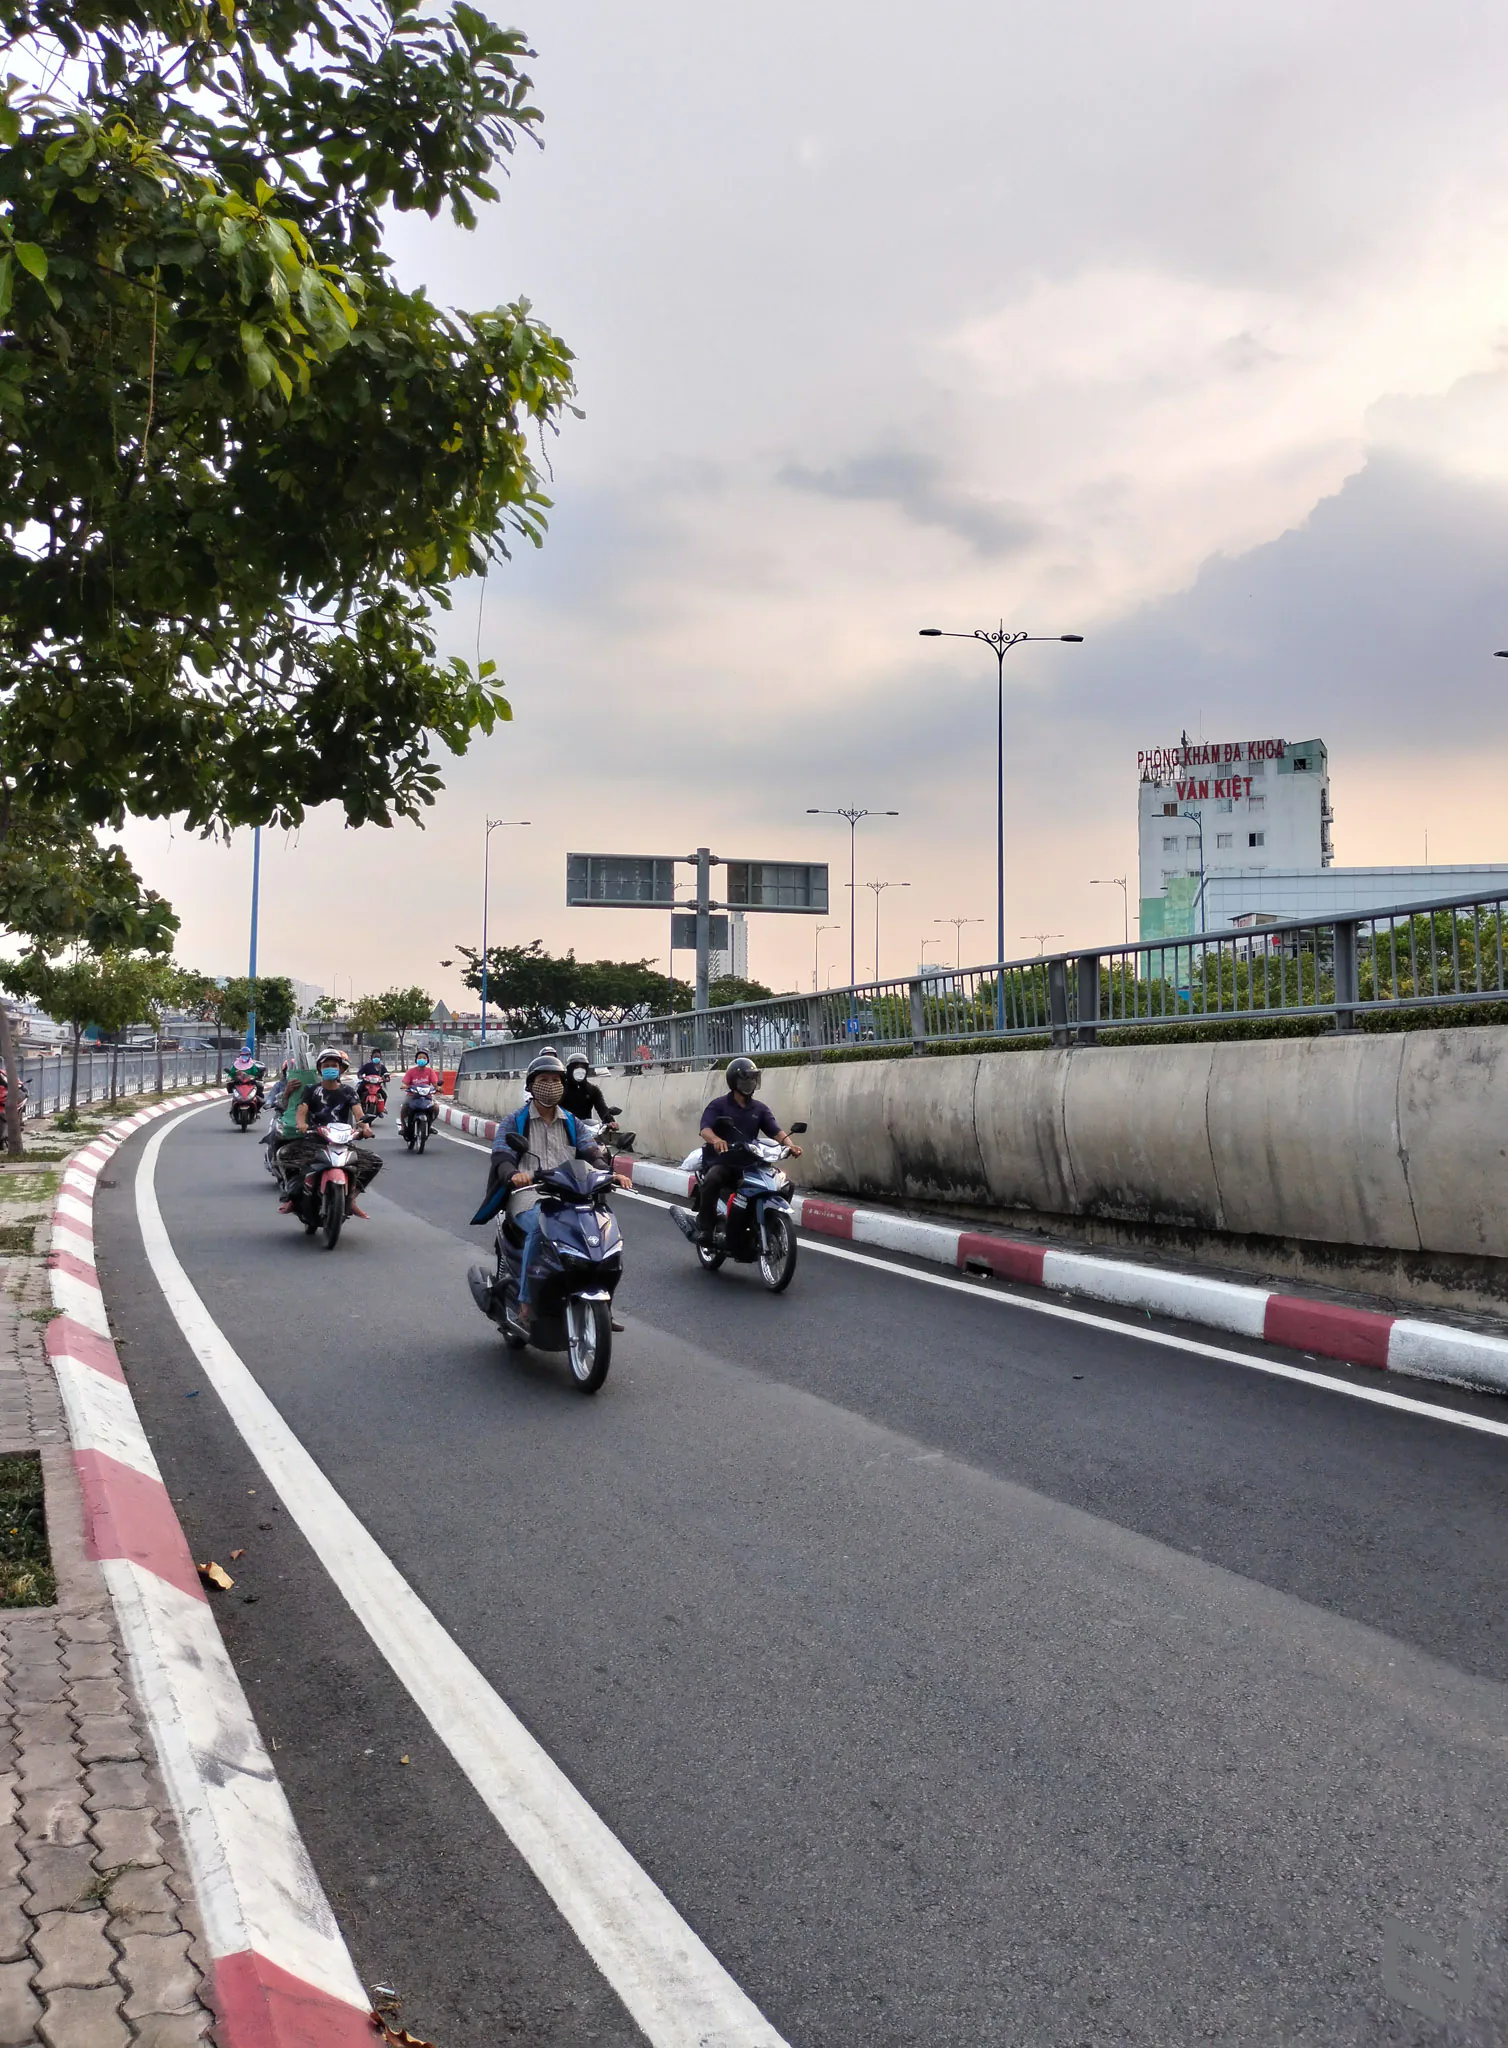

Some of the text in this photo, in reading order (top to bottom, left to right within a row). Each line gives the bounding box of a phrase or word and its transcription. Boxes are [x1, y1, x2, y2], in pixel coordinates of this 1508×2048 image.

[1137, 739, 1285, 769] PHÒNG KHÁM ĐA KHOA
[1176, 774, 1253, 801] VĂN KIỆT
